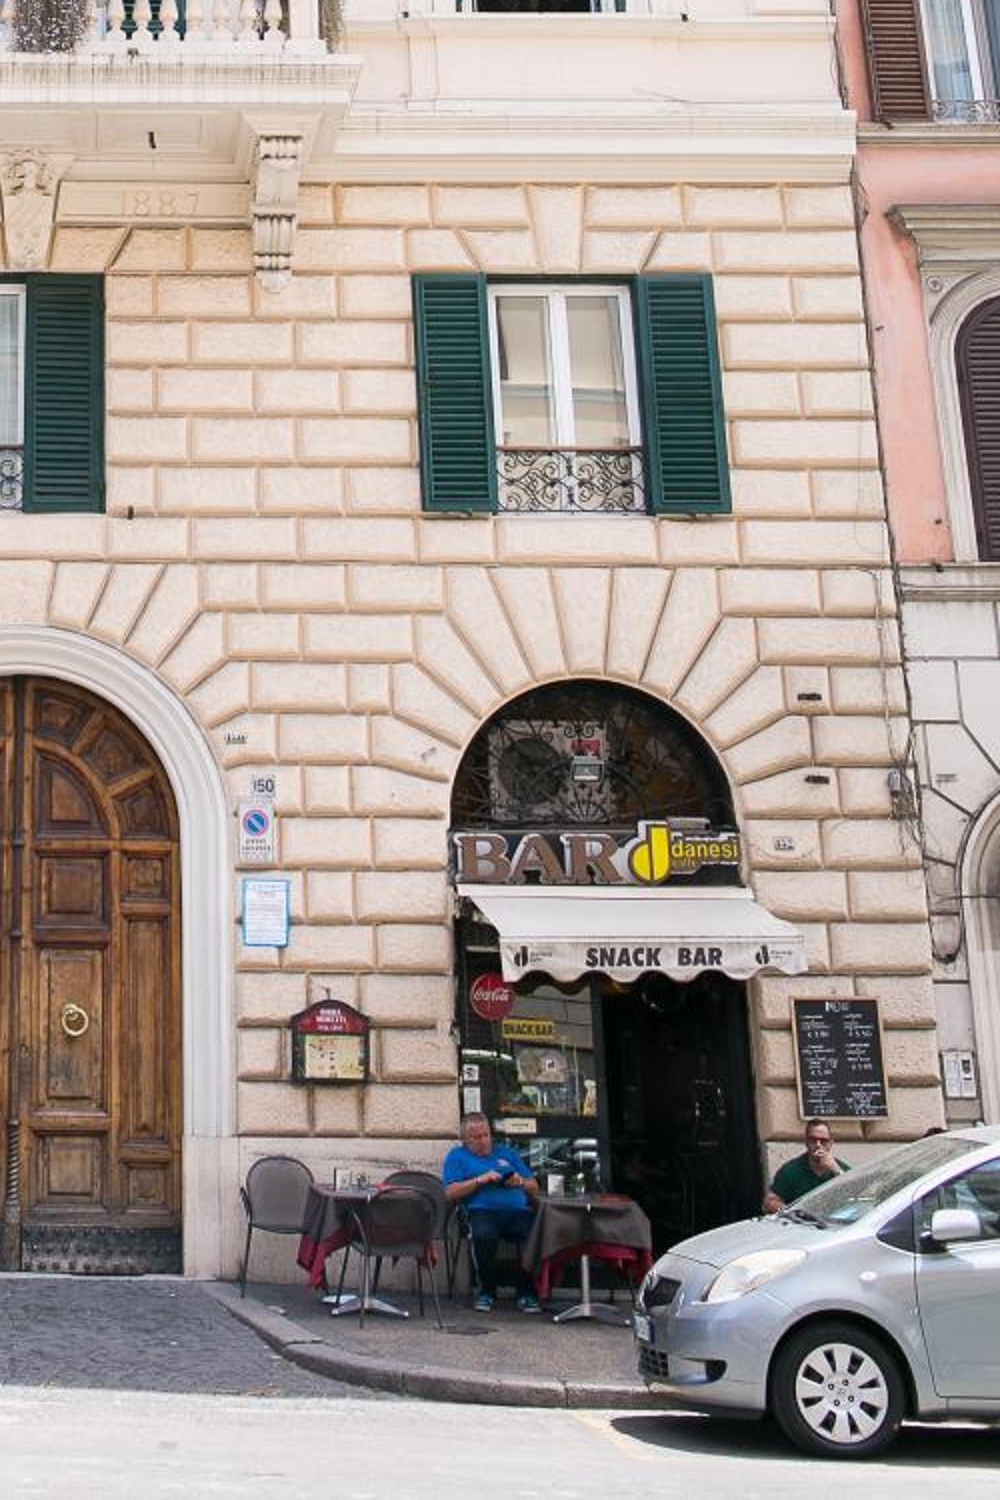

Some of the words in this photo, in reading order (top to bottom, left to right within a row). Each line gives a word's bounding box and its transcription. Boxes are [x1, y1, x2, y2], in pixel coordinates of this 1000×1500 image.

[120, 190, 200, 216] 1887
[455, 833, 624, 884] BAR
[671, 839, 738, 859] danesi
[585, 947, 662, 968] SNACK
[677, 947, 723, 967] BAR
